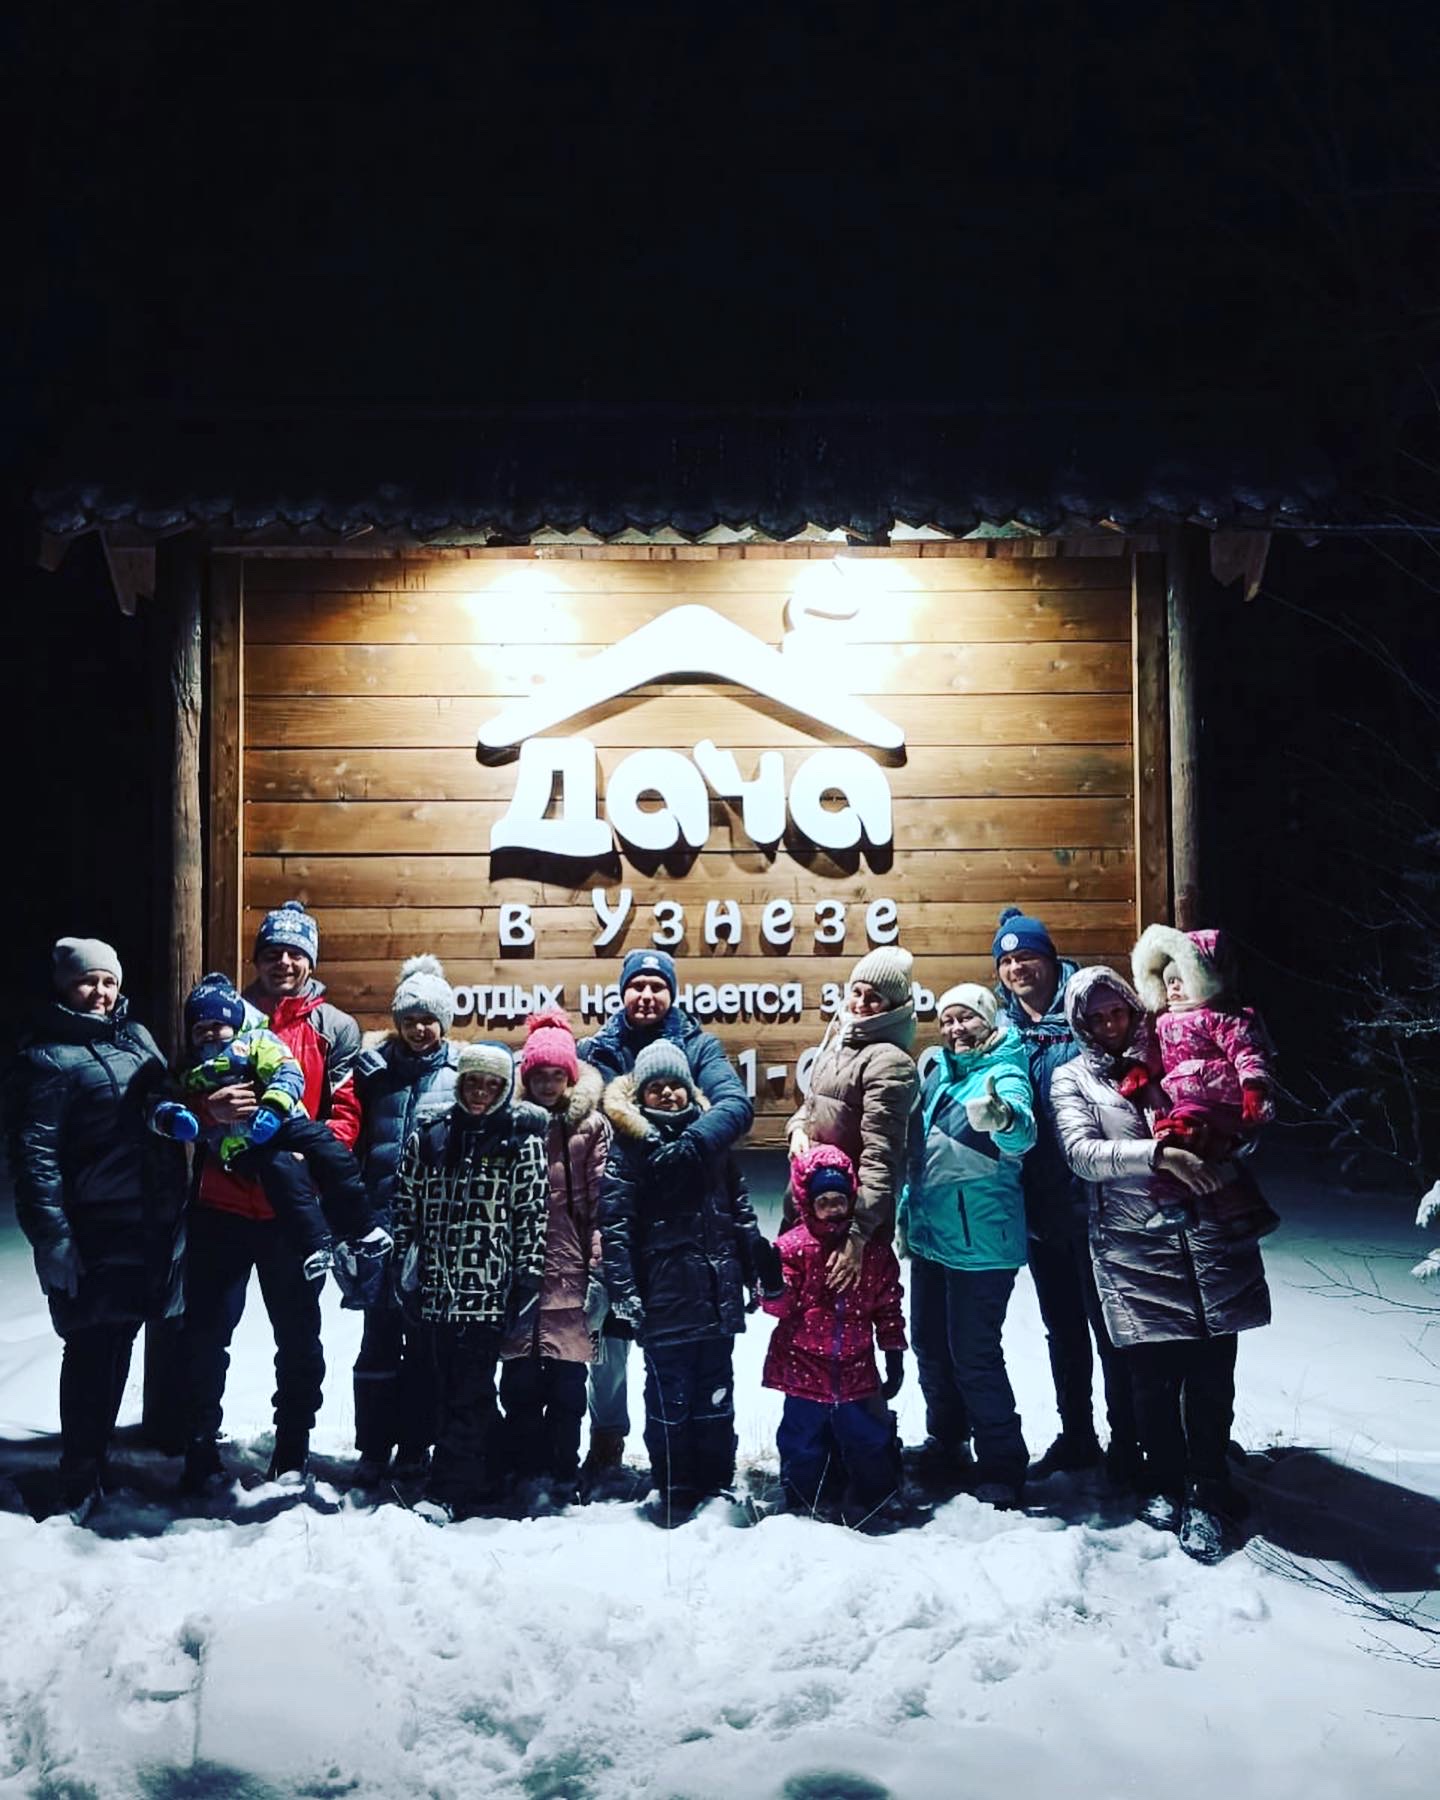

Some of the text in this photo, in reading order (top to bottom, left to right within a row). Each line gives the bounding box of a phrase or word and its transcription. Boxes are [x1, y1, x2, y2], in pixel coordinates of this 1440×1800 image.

[490, 738, 894, 857] Дача
[501, 888, 899, 946] в Узнезе
[454, 984, 564, 1019] отдых
[581, 983, 802, 1014] нанается
